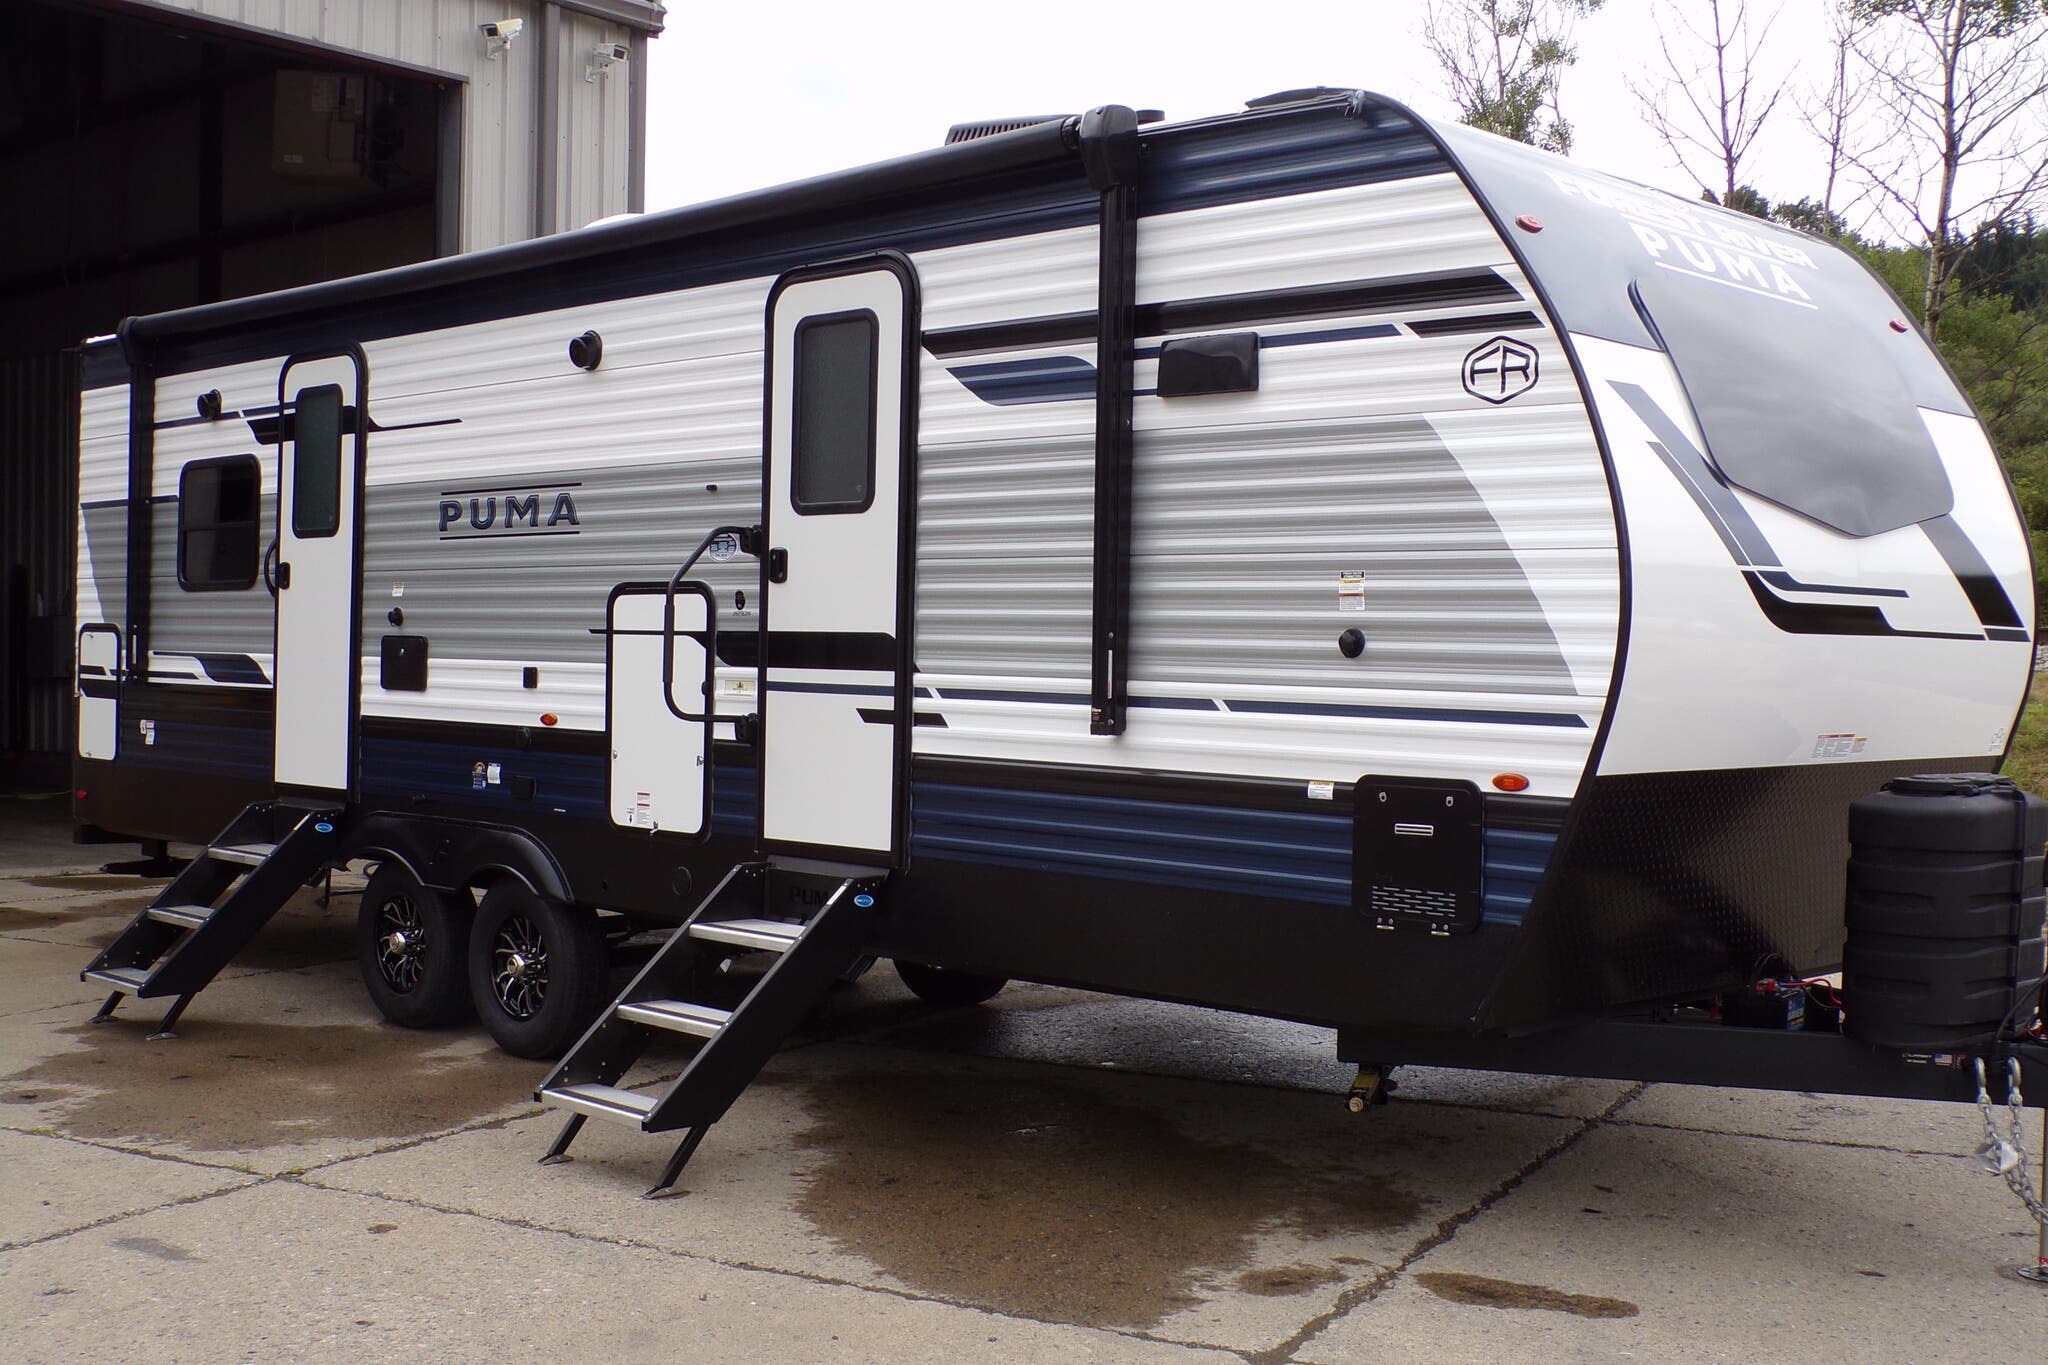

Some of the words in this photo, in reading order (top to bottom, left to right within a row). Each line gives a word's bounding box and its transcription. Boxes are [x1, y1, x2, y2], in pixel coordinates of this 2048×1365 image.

[1628, 221, 1812, 301] PUMA
[1705, 220, 1819, 270] RIVER
[1470, 345, 1530, 394] FR
[439, 492, 581, 532] PUMA
